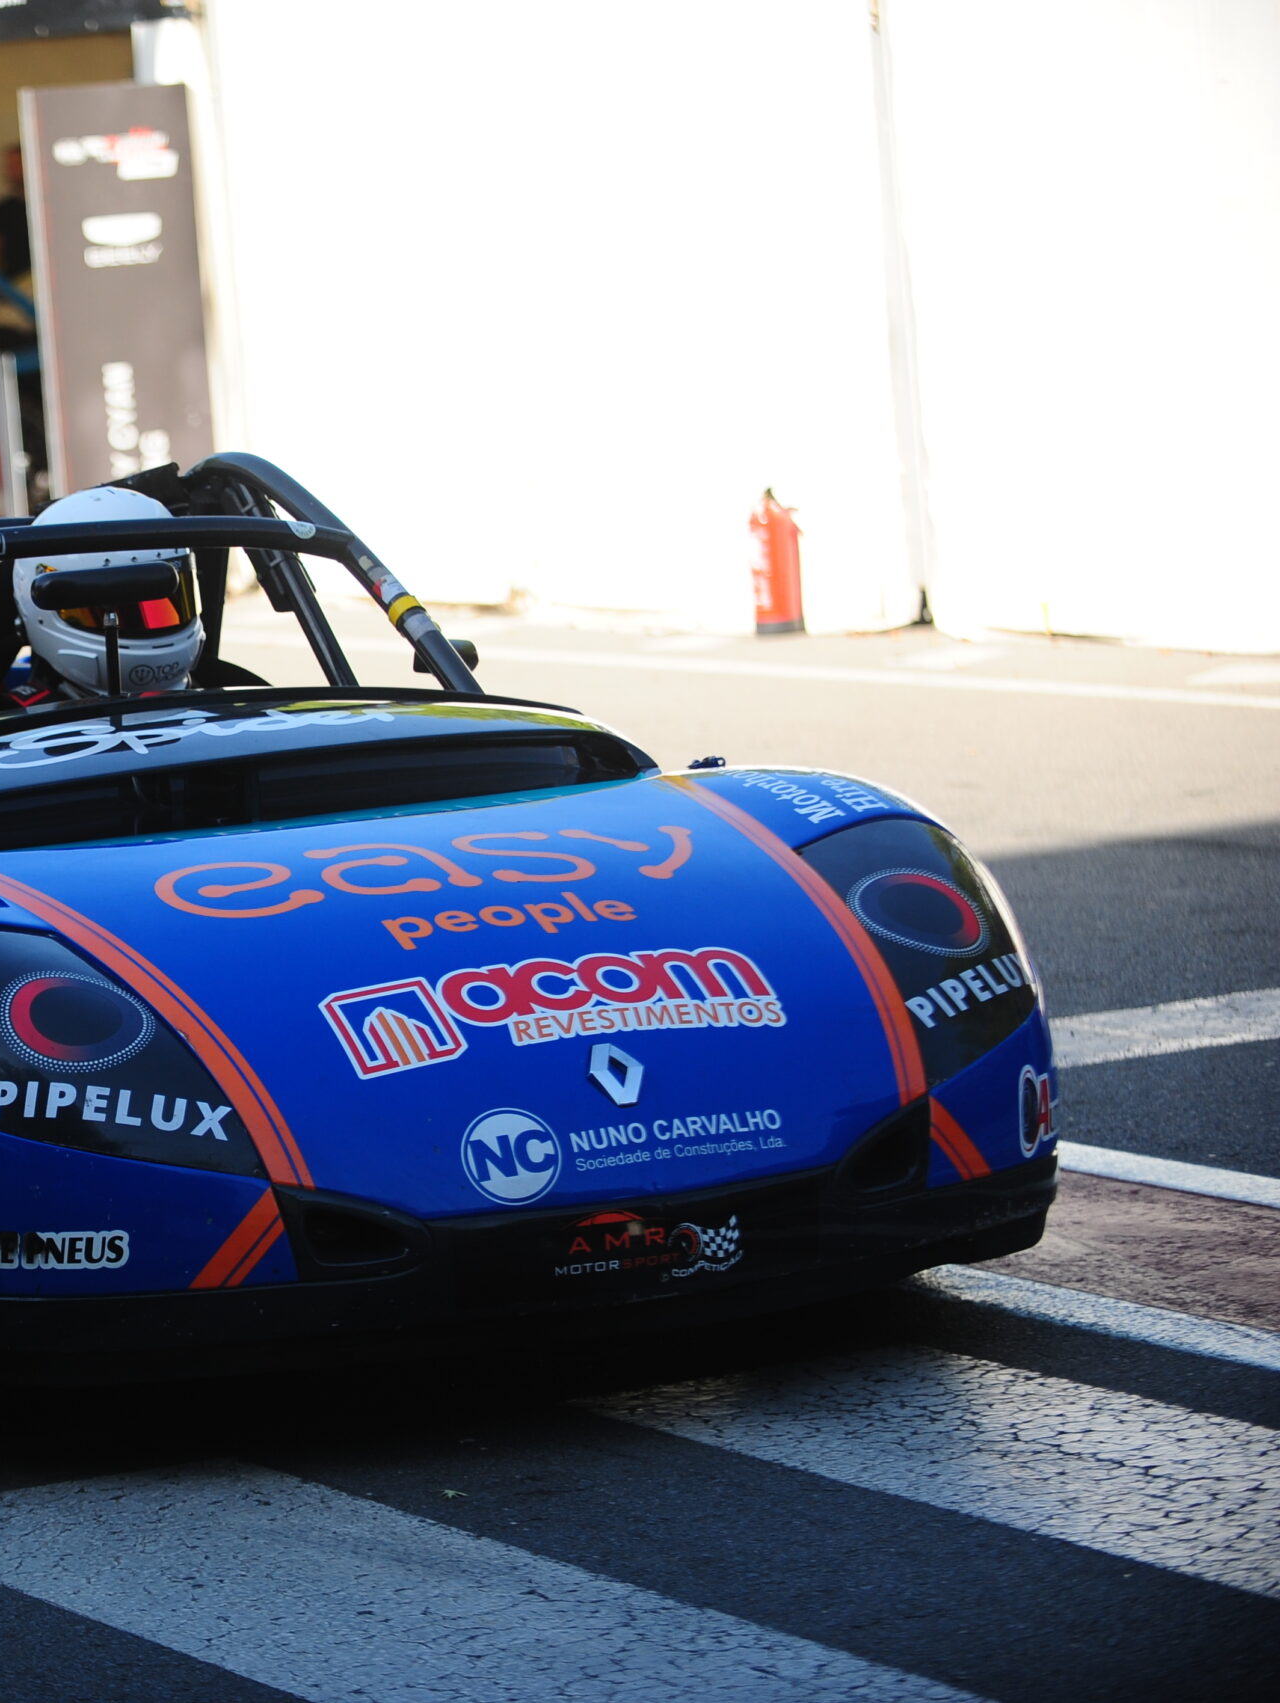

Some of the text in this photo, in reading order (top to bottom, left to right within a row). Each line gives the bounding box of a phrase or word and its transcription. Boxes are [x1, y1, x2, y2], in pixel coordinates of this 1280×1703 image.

[154, 825, 694, 919] easy
[380, 891, 638, 950] people
[438, 946, 778, 1026] acom
[512, 999, 786, 1043] REVESTIMENTOS
[569, 1108, 783, 1153] NUNO CARVALHO
[575, 1149, 652, 1173] Sociedade
[653, 1141, 672, 1160] de
[759, 1135, 788, 1150] Lda.
[467, 1128, 558, 1184] NC
[554, 1252, 681, 1277] MOTORSPORT
